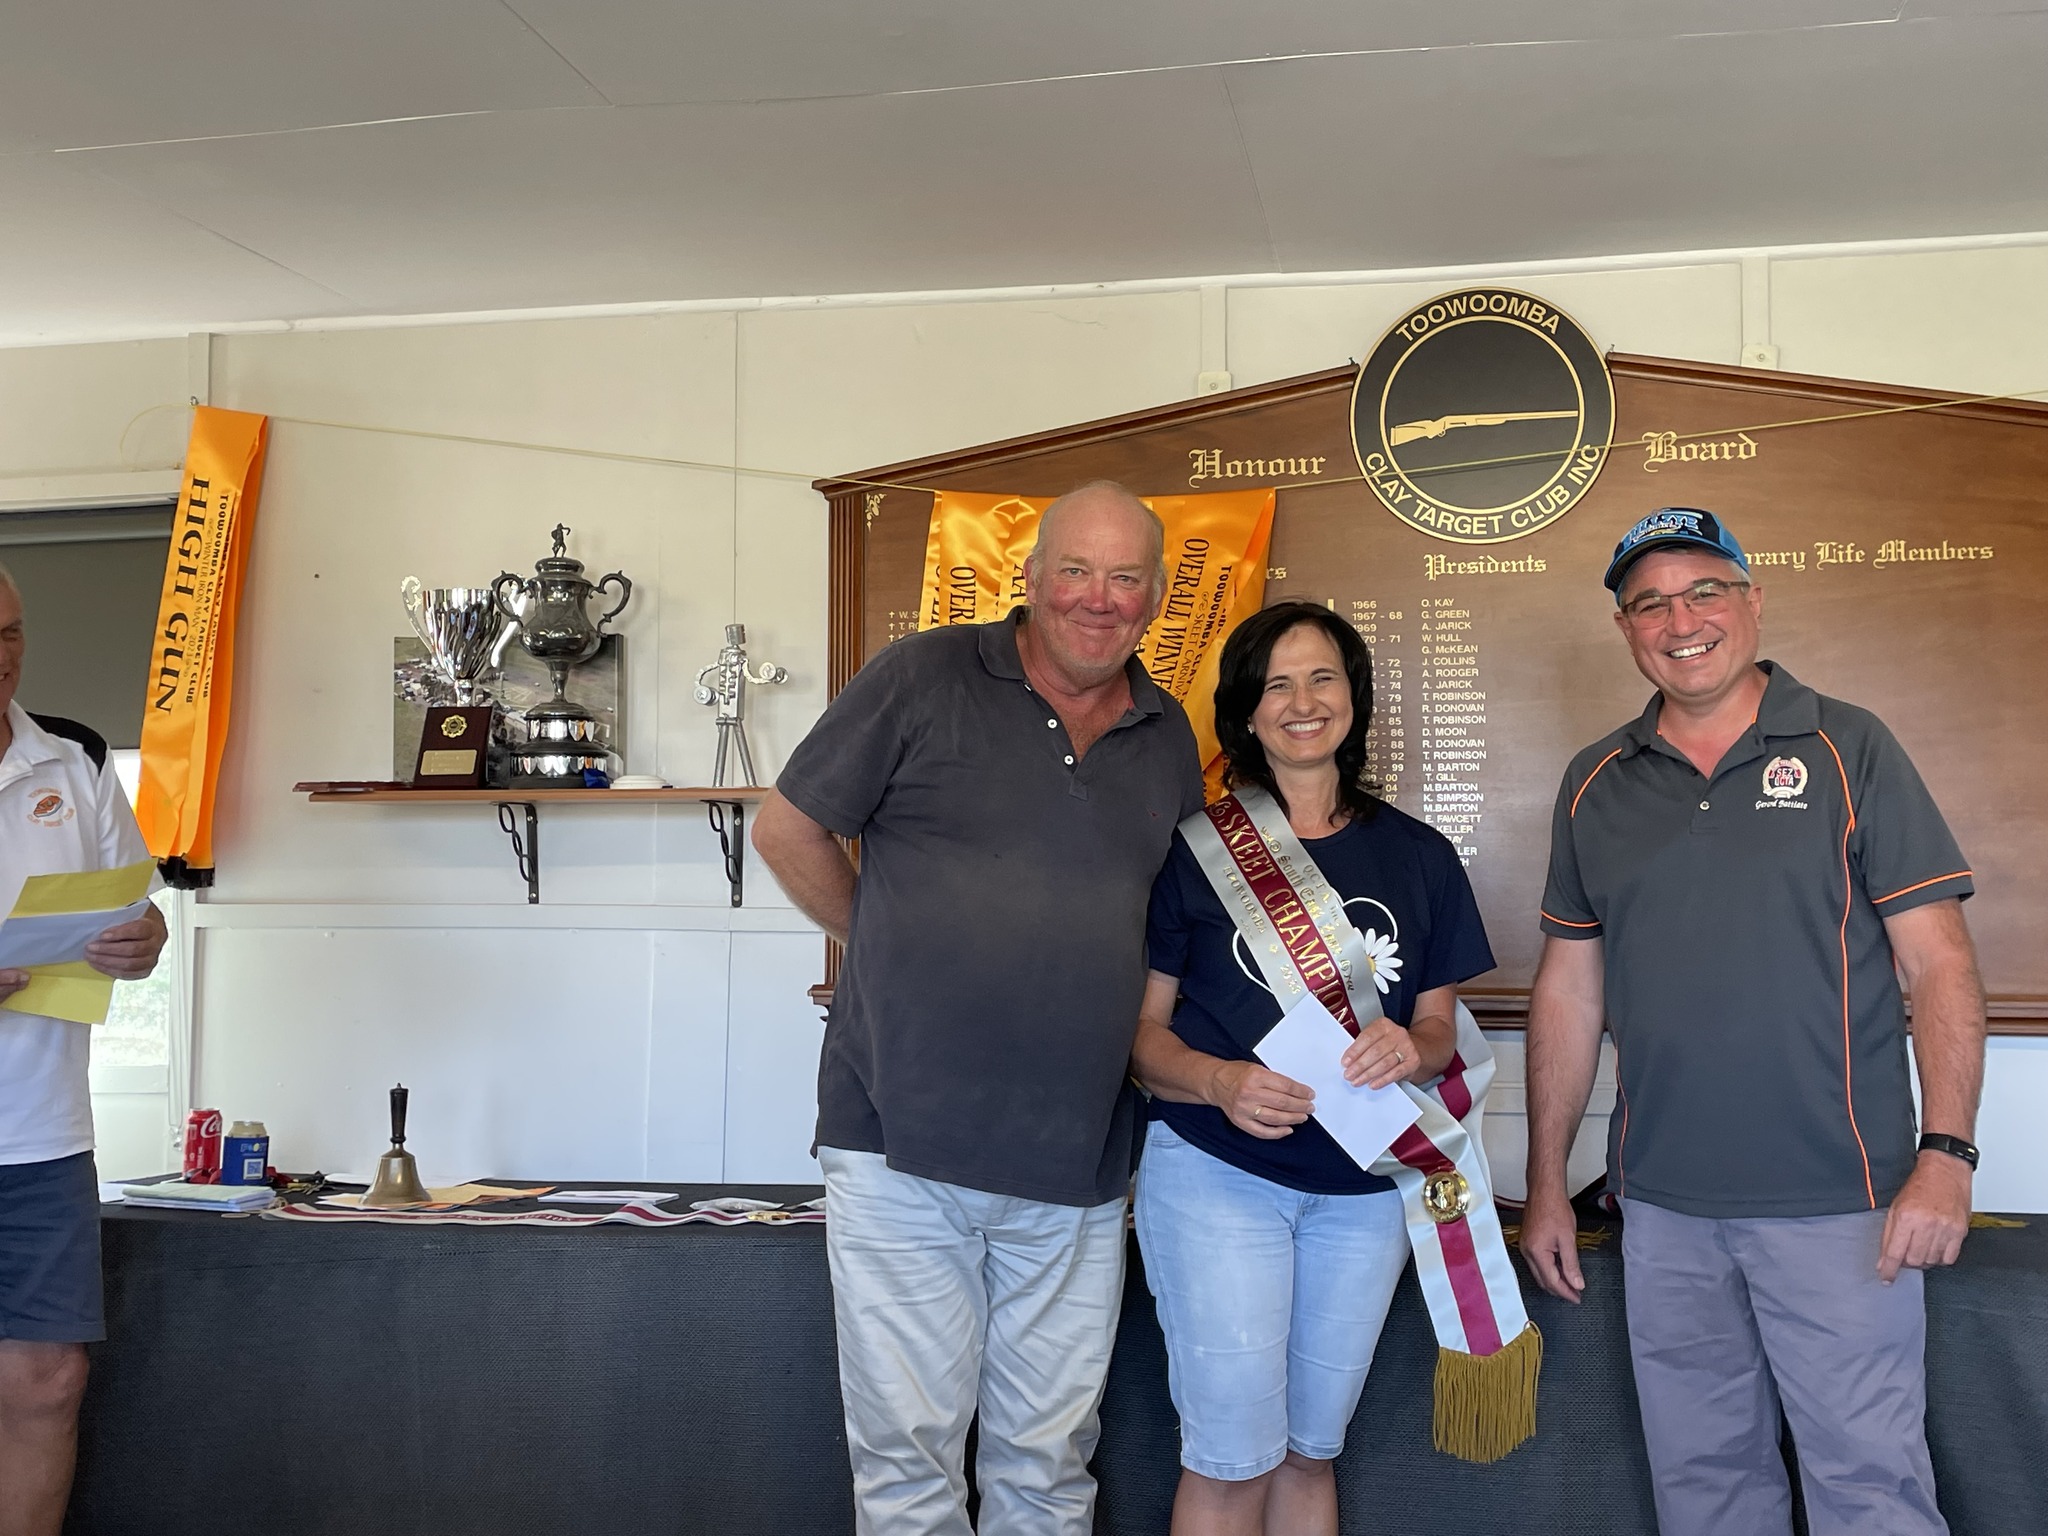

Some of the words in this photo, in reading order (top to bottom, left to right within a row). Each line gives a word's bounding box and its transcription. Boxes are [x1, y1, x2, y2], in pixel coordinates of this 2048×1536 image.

[1395, 294, 1560, 342] TOOWOOMBA
[1188, 448, 1326, 488] Honour
[1642, 431, 1759, 473] Board
[1365, 452, 1412, 505] CLAY
[1412, 499, 1504, 535] TARGET
[1510, 484, 1570, 528] CLUB
[1567, 443, 1600, 486] INC
[174, 473, 210, 599] HIGH
[209, 494, 229, 577] TOOWOOMBA
[1423, 554, 1547, 581] Presidents
[1745, 550, 1806, 572] rary
[1814, 541, 1866, 570] Life
[1873, 539, 1994, 570] Members
[195, 579, 207, 604] IRON
[1163, 538, 1210, 622] OVERALL
[203, 581, 214, 614] CLAY
[949, 566, 977, 625] OVER
[1198, 565, 1232, 649] TOOWOOMBA
[1352, 601, 1377, 609] 1966
[1421, 599, 1431, 607] O.
[1352, 612, 1376, 620] 1967
[1389, 611, 1402, 620] 68
[1421, 611, 1432, 619] G.
[1435, 610, 1470, 618] GREEN
[1353, 624, 1377, 632] 1969
[1435, 622, 1472, 630] JARICK
[193, 618, 208, 667] TARGET
[1188, 614, 1205, 646] SKEET
[1389, 635, 1400, 643] 71
[1436, 634, 1461, 642] HULL
[1150, 626, 1187, 690] WINNE
[1388, 659, 1400, 667] 72
[1433, 657, 1475, 665] COLLINS
[1422, 646, 1431, 654] G.
[1435, 645, 1478, 653] McKEAN
[155, 612, 189, 715] GUN
[1173, 649, 1194, 698] CARNIVA
[1186, 653, 1202, 684] CLAY
[1389, 670, 1402, 678] 73
[1422, 669, 1432, 677] A.
[1436, 668, 1479, 677] RODGER
[185, 671, 198, 703] CLUB
[1388, 694, 1401, 702] 79
[1422, 693, 1429, 701] T.
[1433, 692, 1486, 700] ROBINSON
[1390, 682, 1401, 690] 74
[1422, 681, 1432, 689] A.
[1436, 680, 1472, 689] JARICK
[1389, 717, 1401, 725] 85
[1422, 716, 1430, 724] T.
[1433, 715, 1486, 724] ROBINSON
[1435, 704, 1484, 712] DONOVAN
[1366, 741, 1377, 749] 87
[1391, 741, 1404, 749] 88
[1422, 740, 1432, 748] R.
[1436, 739, 1484, 748] DONOVAN
[1390, 728, 1404, 737] 86
[1422, 728, 1431, 736] D.
[1435, 728, 1466, 736] MOON
[1391, 752, 1404, 760] 92
[1434, 751, 1487, 759] ROBINSON
[1392, 764, 1403, 772] 99
[1438, 762, 1480, 771] BARTON
[1386, 784, 1398, 792] 04
[1436, 773, 1457, 781] GILL
[1424, 794, 1433, 802] K.
[1437, 793, 1483, 801] SIMPSON
[1425, 815, 1433, 823] E.
[1437, 814, 1482, 822] FAWCETT
[1436, 825, 1473, 833] KELLER
[1458, 847, 1477, 855] LER
[1276, 855, 1304, 888] South
[1222, 866, 1266, 934] TOOWOOMBA
[1219, 813, 1277, 882] SKEET
[1264, 887, 1355, 1029] CHAMPION
